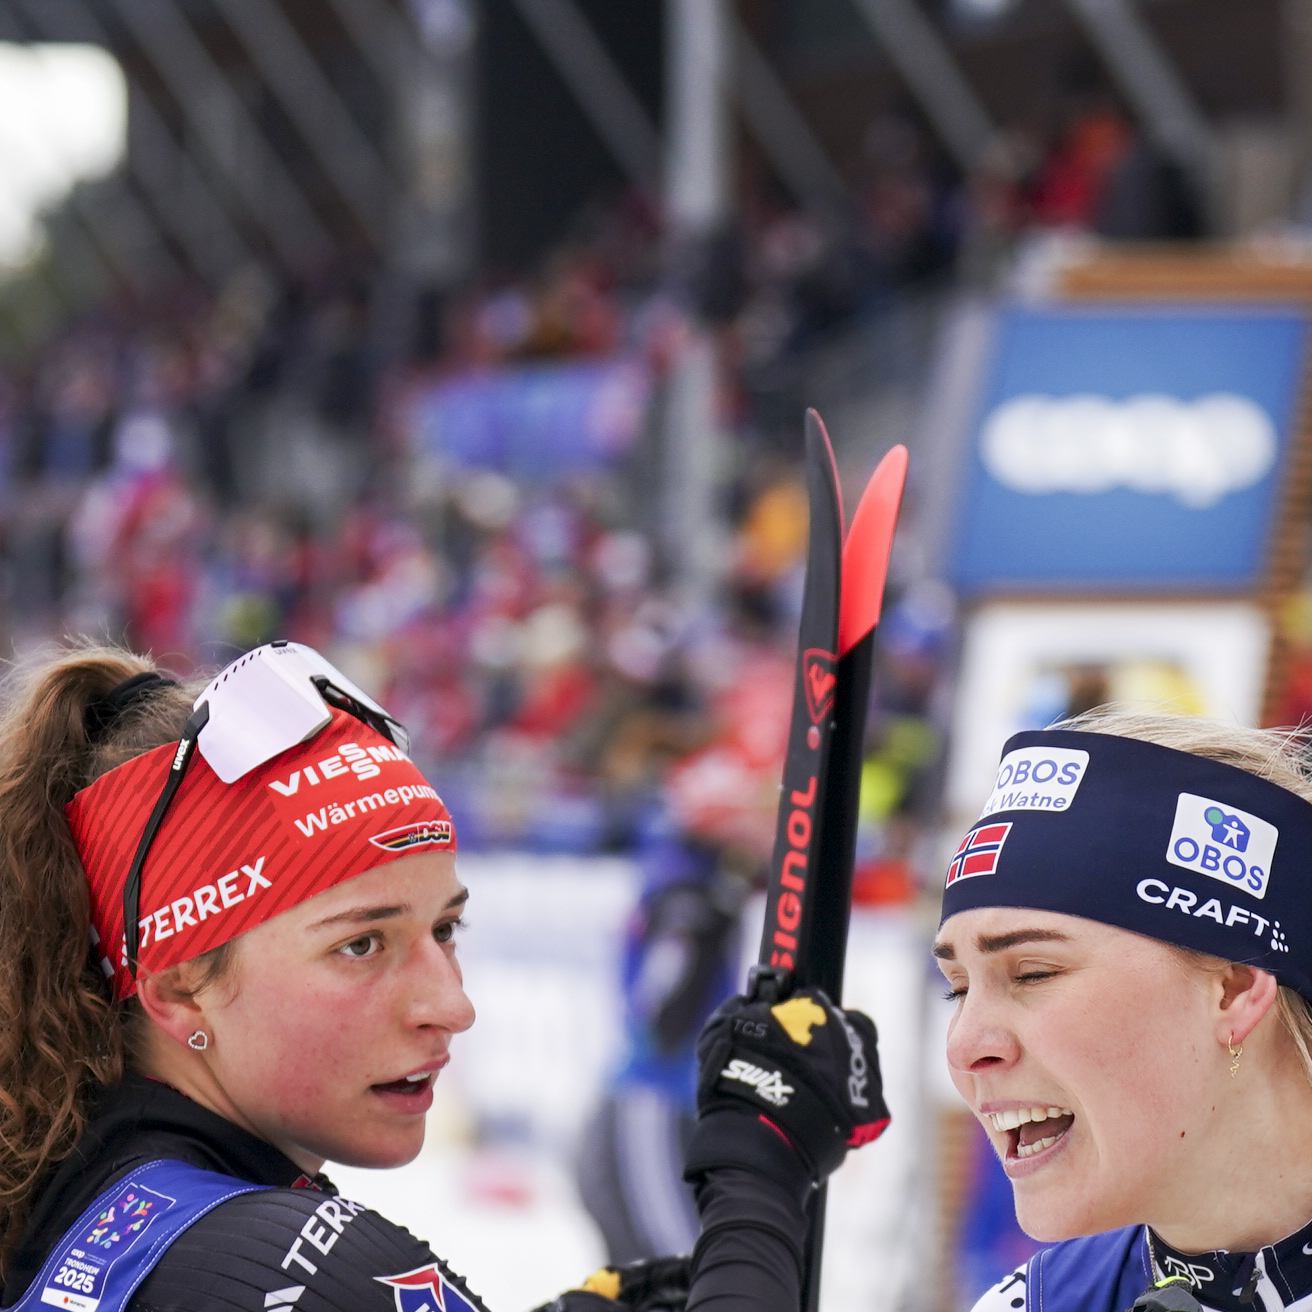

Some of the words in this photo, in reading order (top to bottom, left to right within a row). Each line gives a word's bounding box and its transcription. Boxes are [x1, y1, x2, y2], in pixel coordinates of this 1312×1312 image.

[173, 738, 190, 771] uvex
[268, 743, 413, 797] VIESSMA
[997, 759, 1080, 790] OBOS
[294, 785, 445, 838] Wärmepum
[1000, 791, 1067, 809] Watne
[1174, 837, 1265, 891] OBOS
[138, 856, 273, 948] TERREX
[1136, 878, 1270, 937] CRAFT
[281, 1195, 366, 1275] TERR
[54, 1266, 95, 1294] 2025
